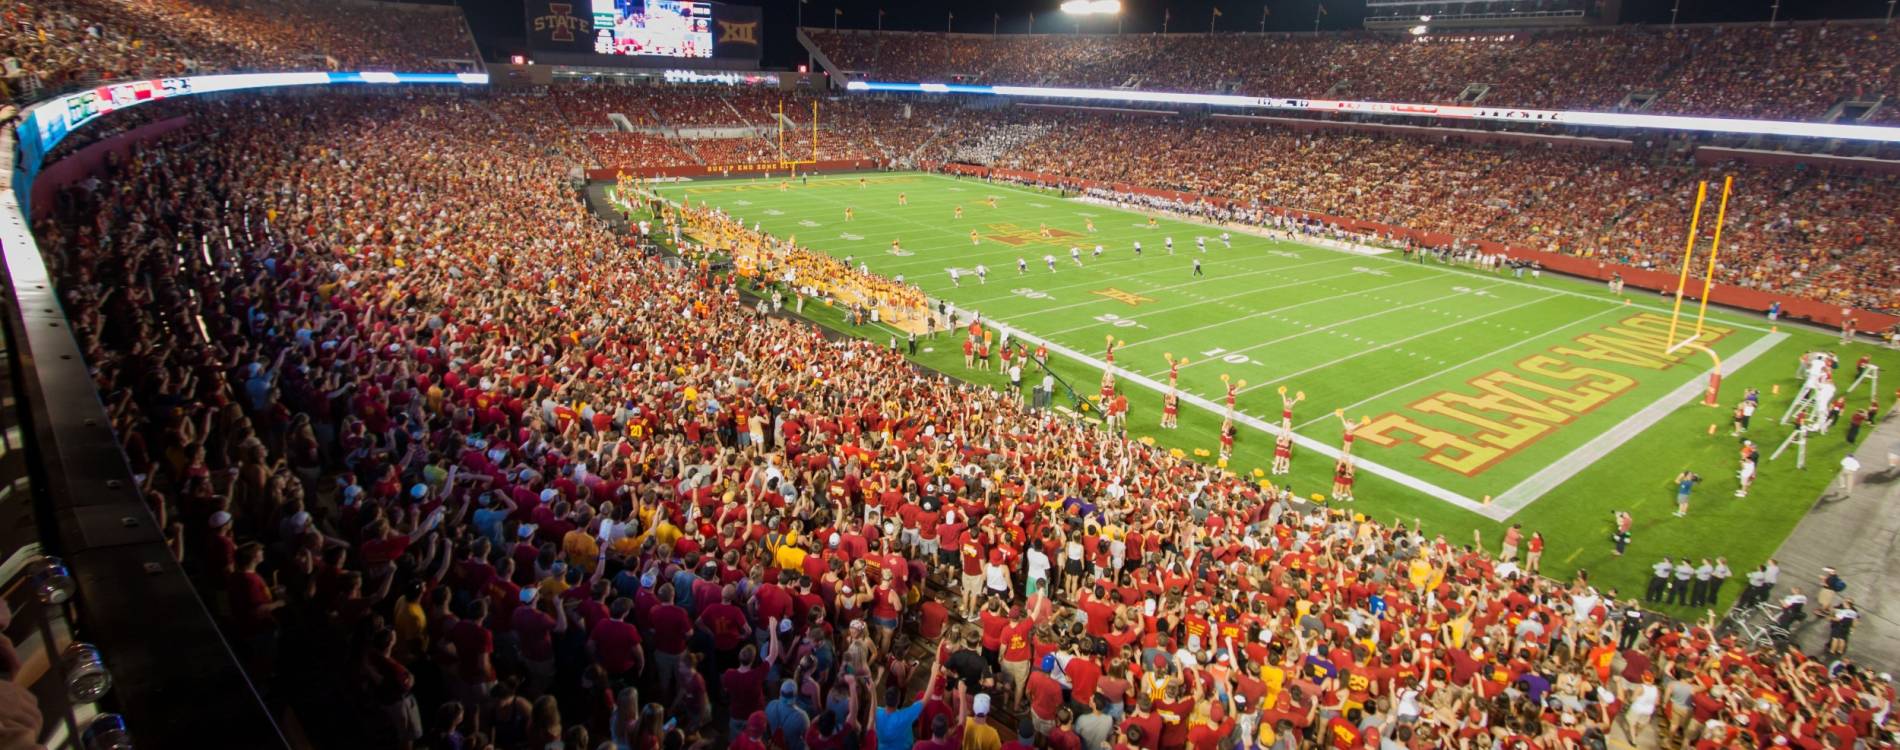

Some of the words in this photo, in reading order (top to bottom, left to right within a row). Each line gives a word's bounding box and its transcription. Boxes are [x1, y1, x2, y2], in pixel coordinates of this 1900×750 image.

[534, 15, 589, 34] STATE
[1200, 347, 1249, 364] 10
[1354, 353, 1639, 477] STATE
[630, 424, 642, 437] 20
